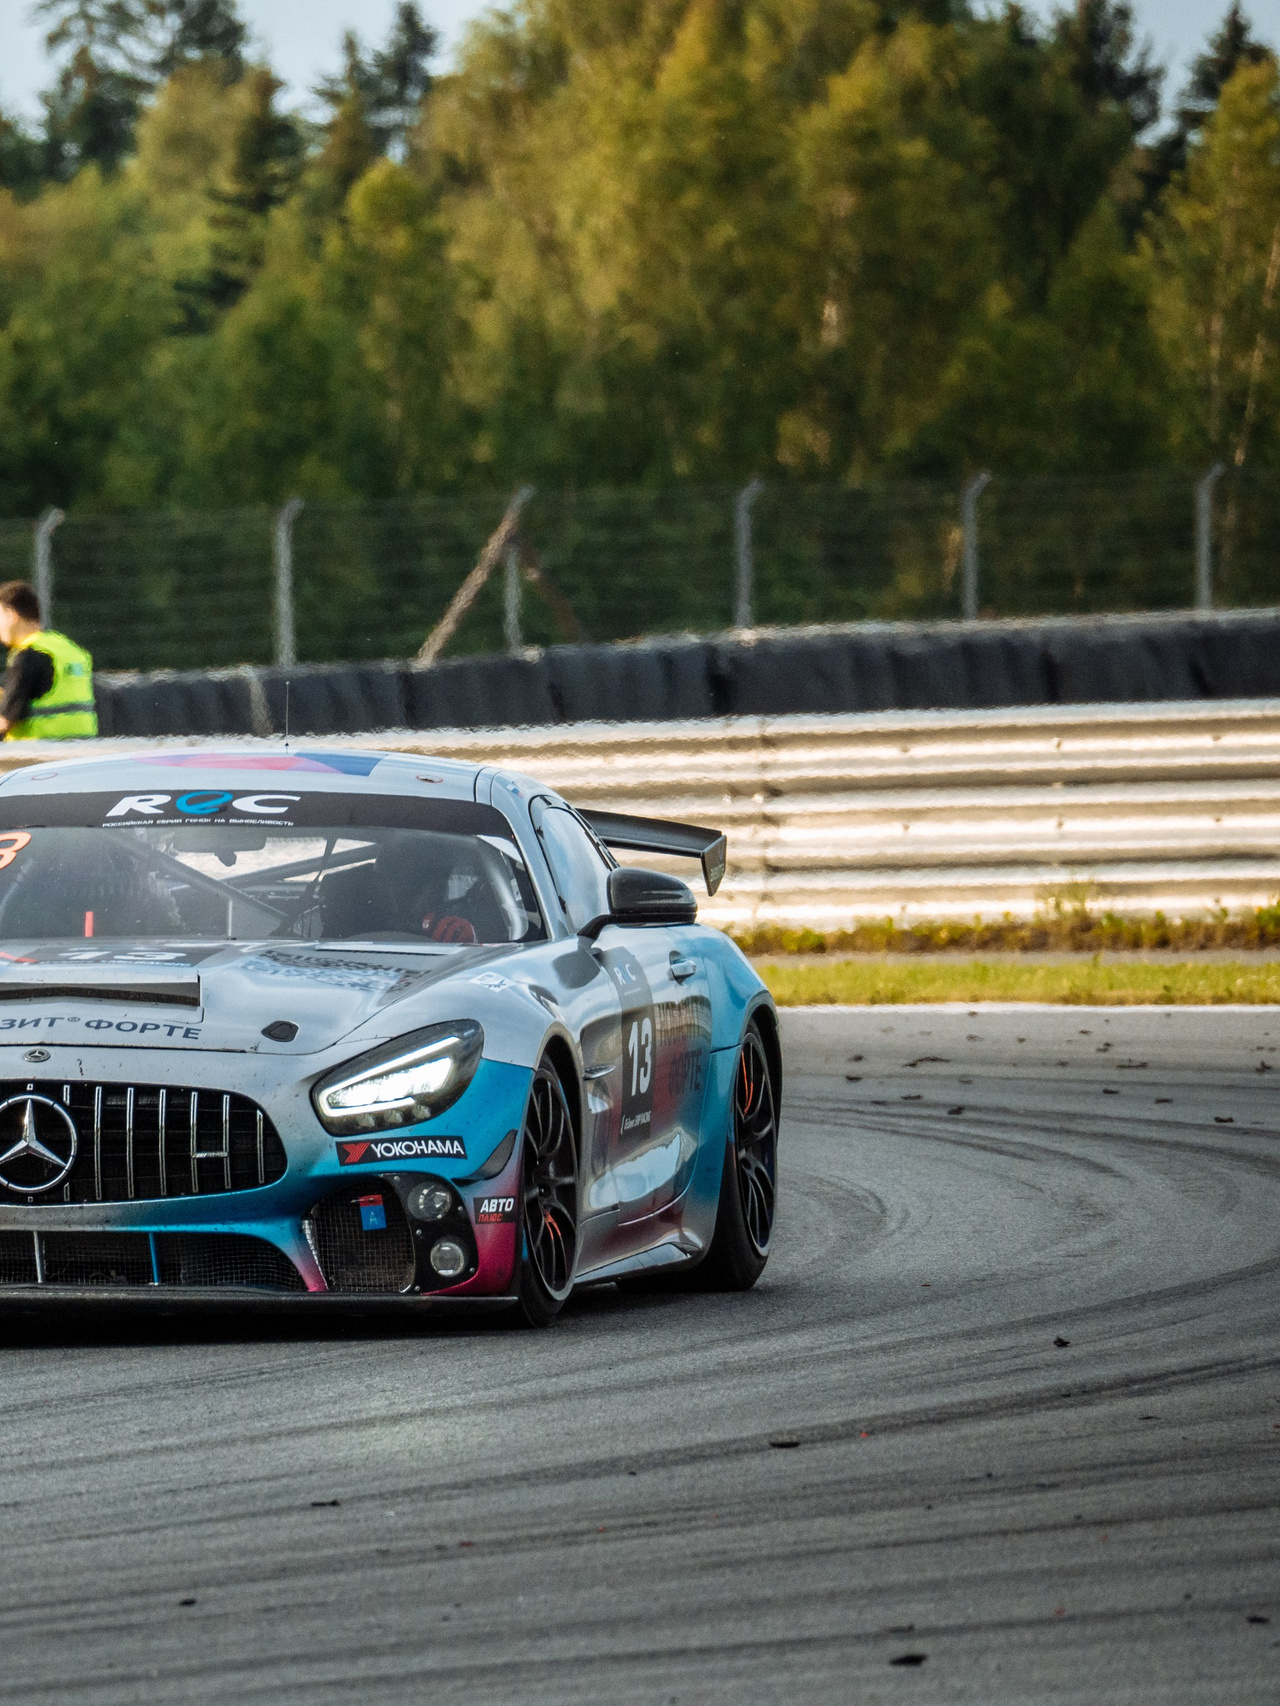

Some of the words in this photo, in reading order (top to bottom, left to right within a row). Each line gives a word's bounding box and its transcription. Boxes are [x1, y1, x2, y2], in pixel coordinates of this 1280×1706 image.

[229, 818, 294, 827] ВЫНОСЛИВОСТЬ
[58, 951, 187, 961] 13
[85, 1018, 202, 1040] ФОРТЕ
[628, 1017, 653, 1097] 13
[370, 1139, 465, 1158] YOKOHAMA
[480, 1197, 515, 1213] АВТО
[478, 1213, 503, 1222] ПЛЮС
